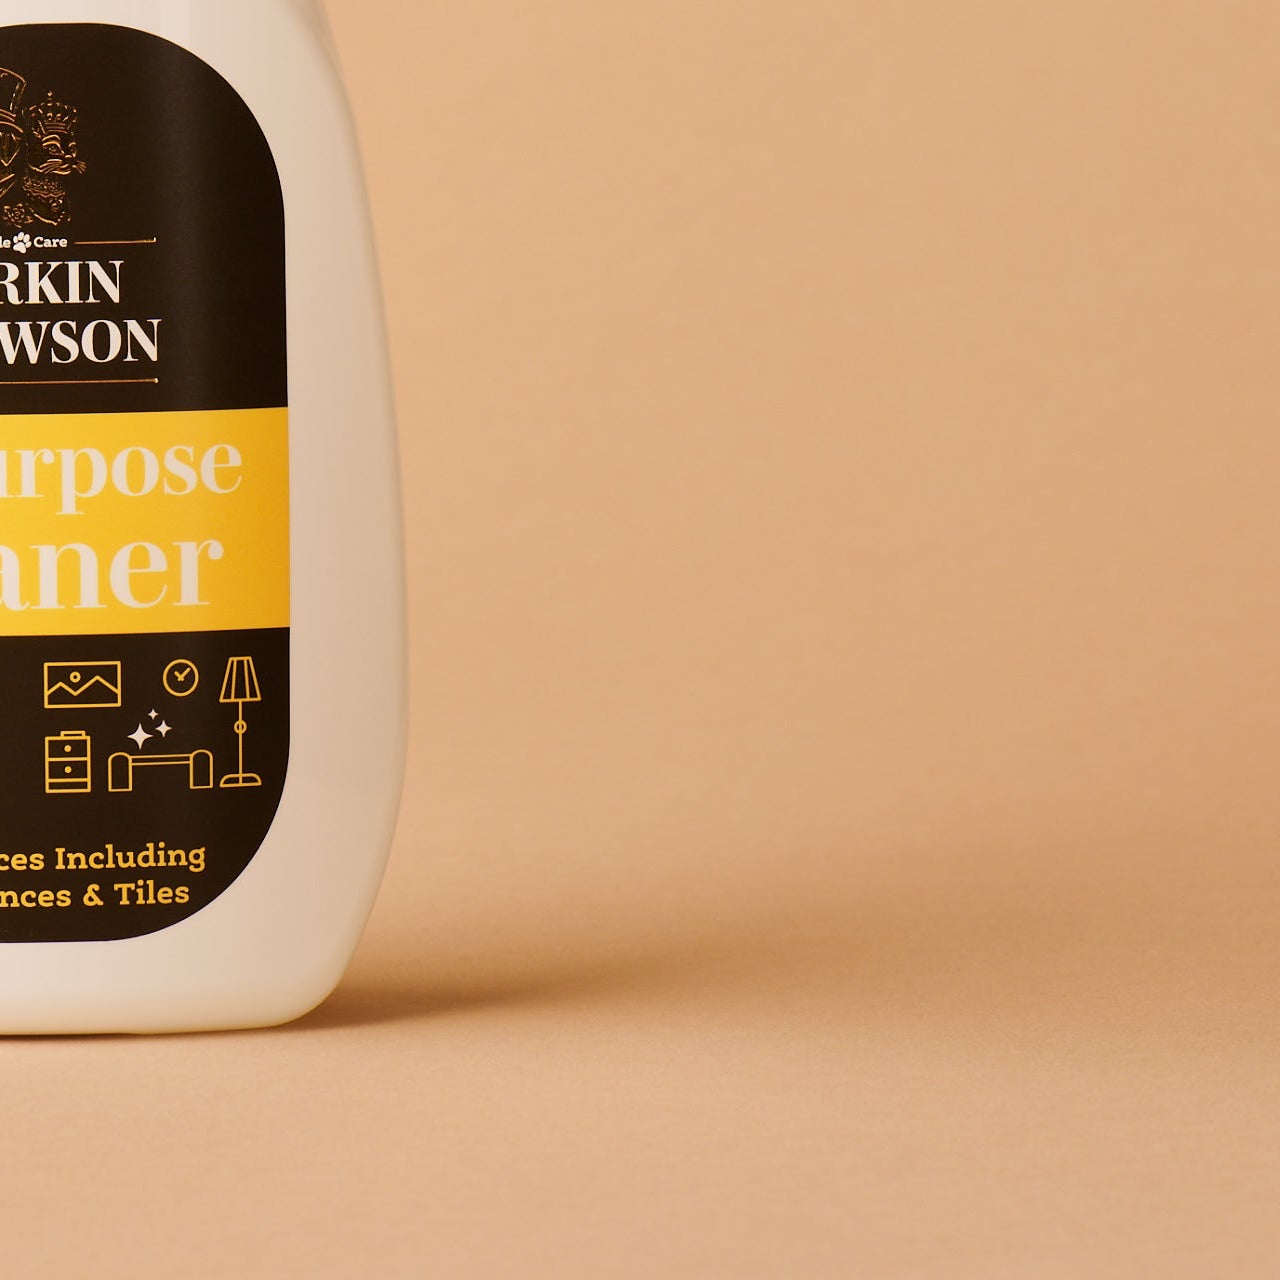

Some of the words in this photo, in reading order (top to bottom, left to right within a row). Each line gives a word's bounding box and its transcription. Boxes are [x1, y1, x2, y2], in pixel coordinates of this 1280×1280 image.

[33, 236, 68, 248] Care
[54, 841, 206, 873] Including
[82, 883, 105, 907] &
[113, 879, 190, 906] Tiles
